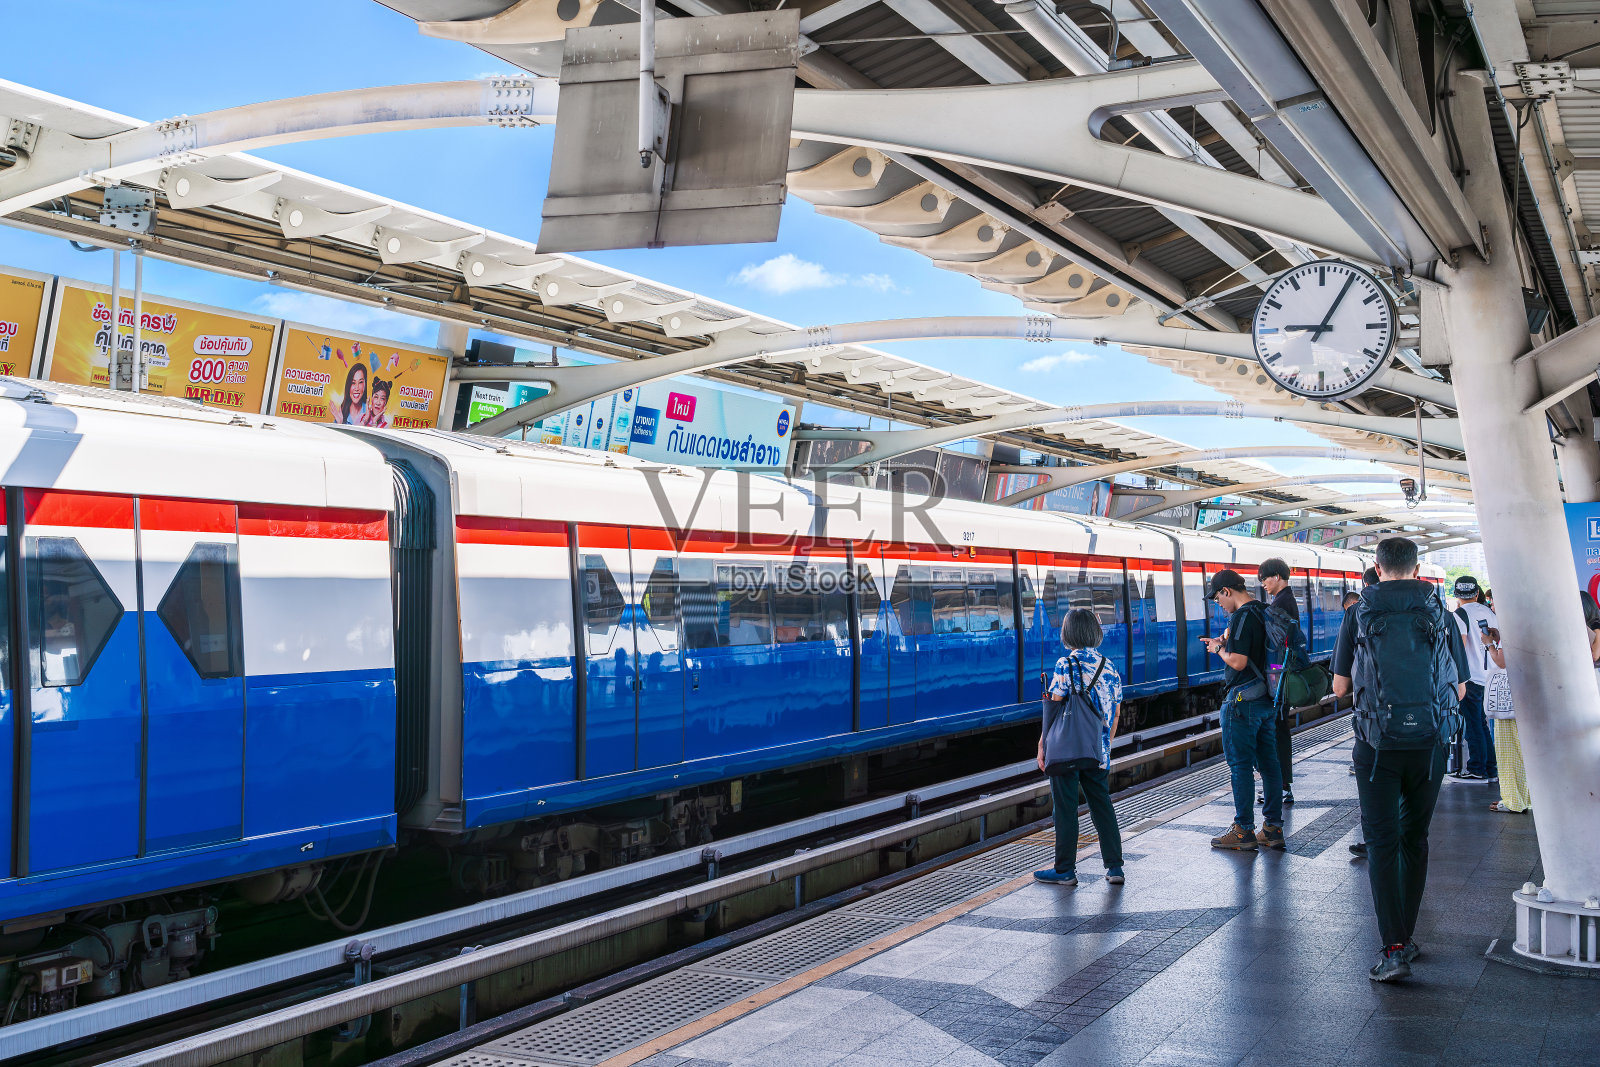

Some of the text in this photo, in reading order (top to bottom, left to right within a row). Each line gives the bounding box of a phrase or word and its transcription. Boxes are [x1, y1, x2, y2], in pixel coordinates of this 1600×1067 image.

[200, 337, 248, 354] ช้อปคุ้มกับ
[189, 359, 226, 382] 800
[228, 361, 249, 371] สาขา
[285, 368, 331, 383] ความสะดวก
[400, 386, 433, 401] ความสนุก
[673, 396, 691, 416] ใหม่
